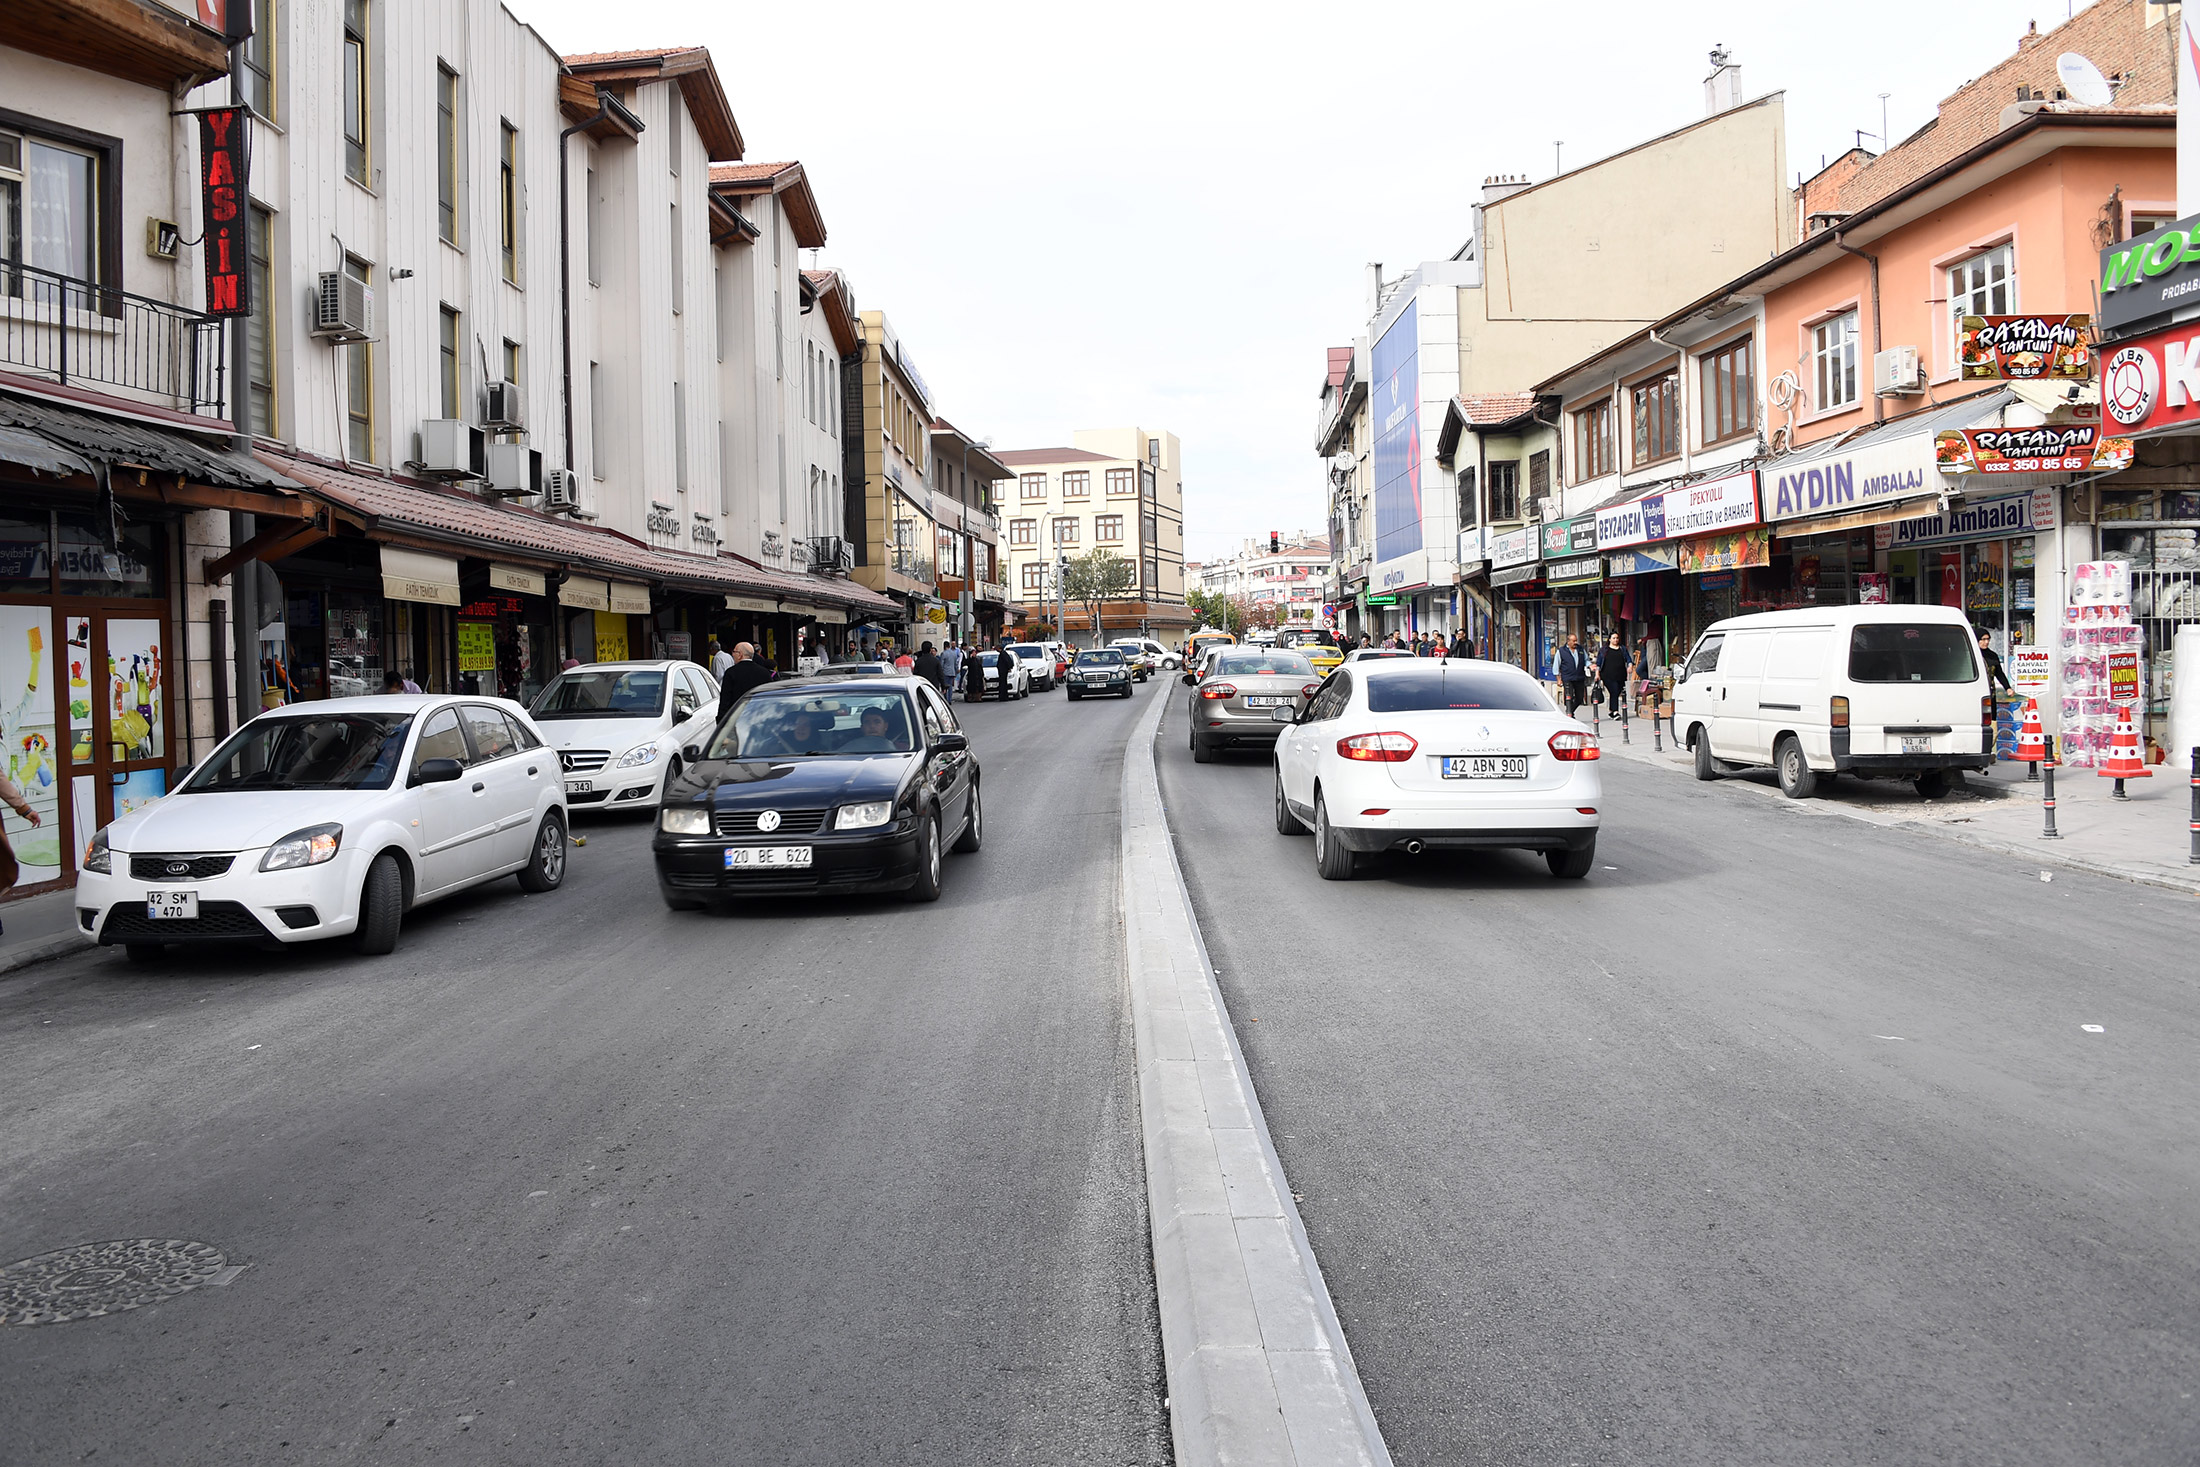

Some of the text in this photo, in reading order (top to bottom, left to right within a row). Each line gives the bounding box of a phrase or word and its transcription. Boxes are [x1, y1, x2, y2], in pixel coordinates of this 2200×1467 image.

[2161, 278, 2200, 301] PROBAB
[1976, 318, 2077, 348] RAFADAN
[2010, 367, 2040, 375] 350 85 65
[2109, 349, 2145, 374] KUBA
[2107, 391, 2150, 422] MOTOR
[1975, 428, 2092, 449] RAFADAN
[1985, 457, 2082, 471] 0332 350 85 65
[1689, 486, 1723, 507] İPEKYOLU
[1776, 461, 1923, 515] AYDIN AMBALAJ
[1599, 511, 1642, 541] BEYZADEM
[1666, 501, 1753, 535] ŞİFALI BİTKİLER ve BAHARAT
[1949, 499, 2024, 534] Ambalaj
[1544, 527, 1568, 550] Berat
[405, 582, 440, 599] FATİH TEMİZLİK
[2017, 652, 2049, 661] TUĞRA
[2110, 656, 2135, 667] RAFADAN
[1253, 697, 1260, 705] 42
[1451, 759, 1466, 773] 42
[1472, 759, 1496, 773] ABN
[1501, 759, 1524, 772] 900
[574, 783, 590, 792] 343
[733, 848, 810, 864] 20 BE 622
[150, 893, 188, 905] 42 SM
[163, 906, 183, 917] 470
